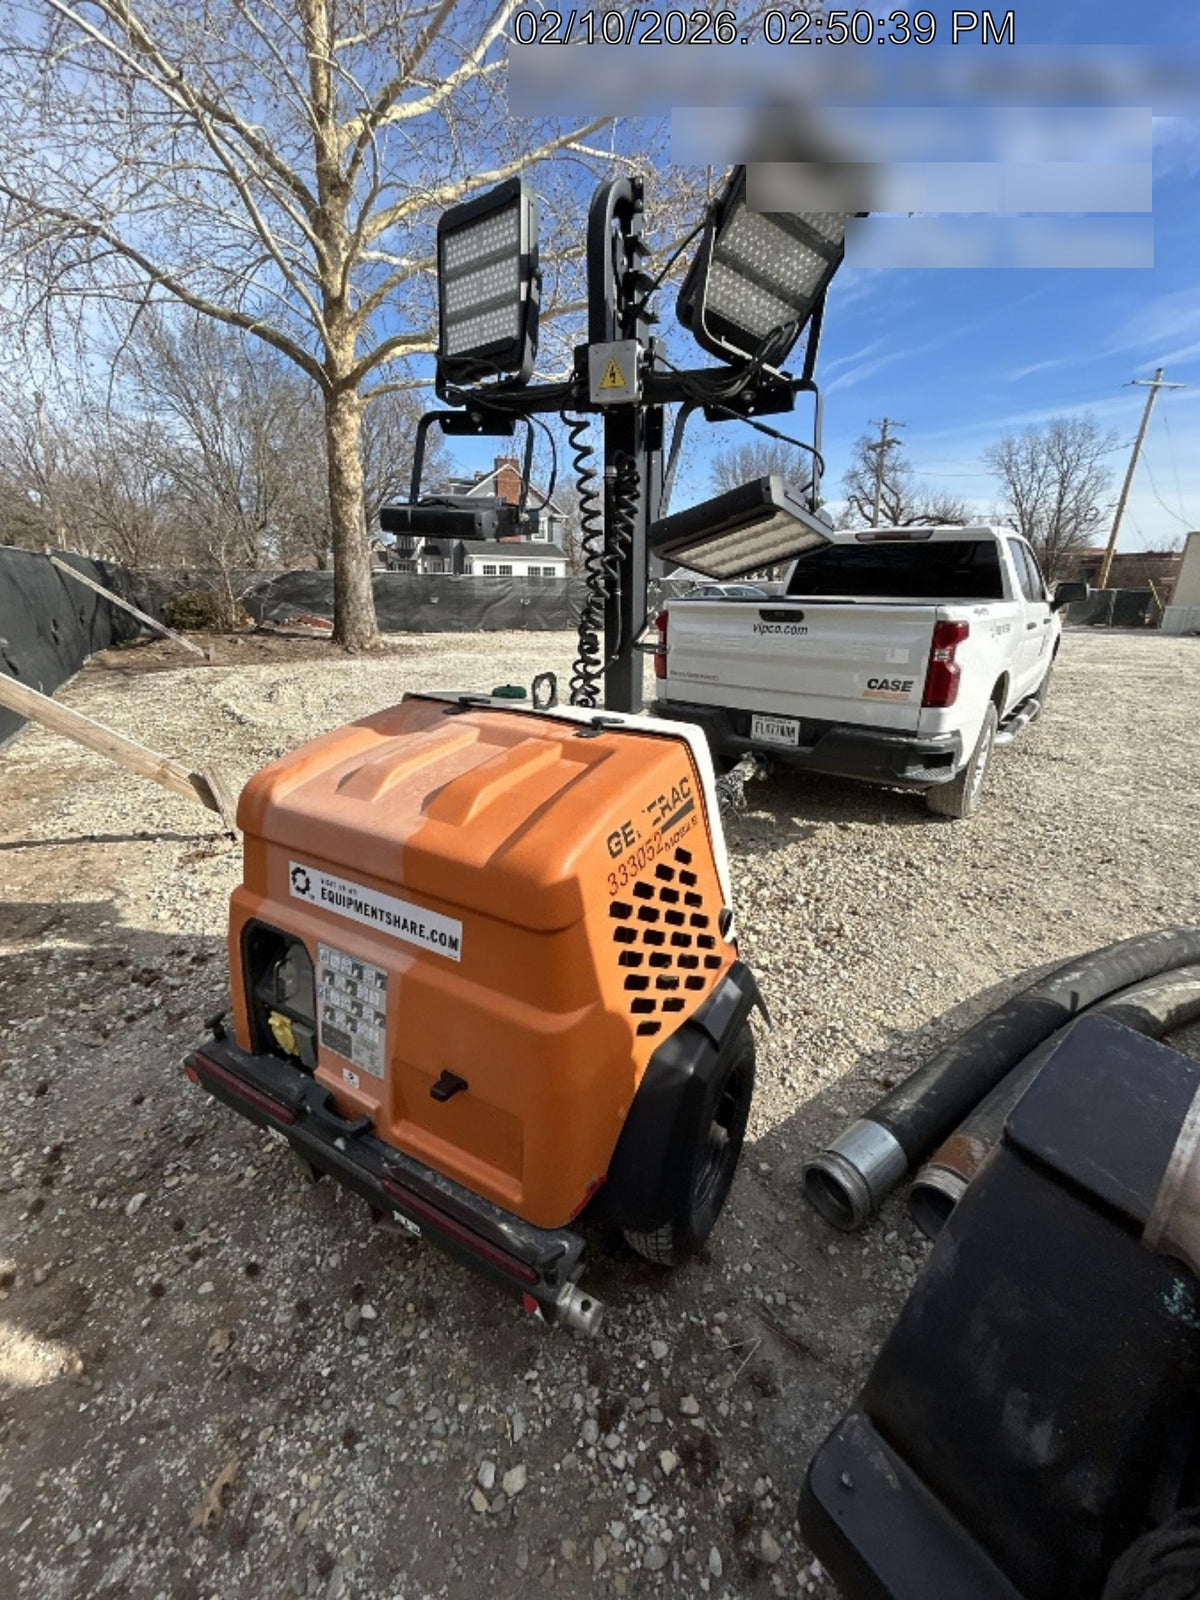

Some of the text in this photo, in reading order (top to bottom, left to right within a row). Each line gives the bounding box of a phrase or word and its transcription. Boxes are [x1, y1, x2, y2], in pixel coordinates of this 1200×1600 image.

[866, 678, 915, 693] CASE
[607, 831, 664, 897] 333052
[321, 886, 460, 952] EQUIPMENTSHARE.COM
